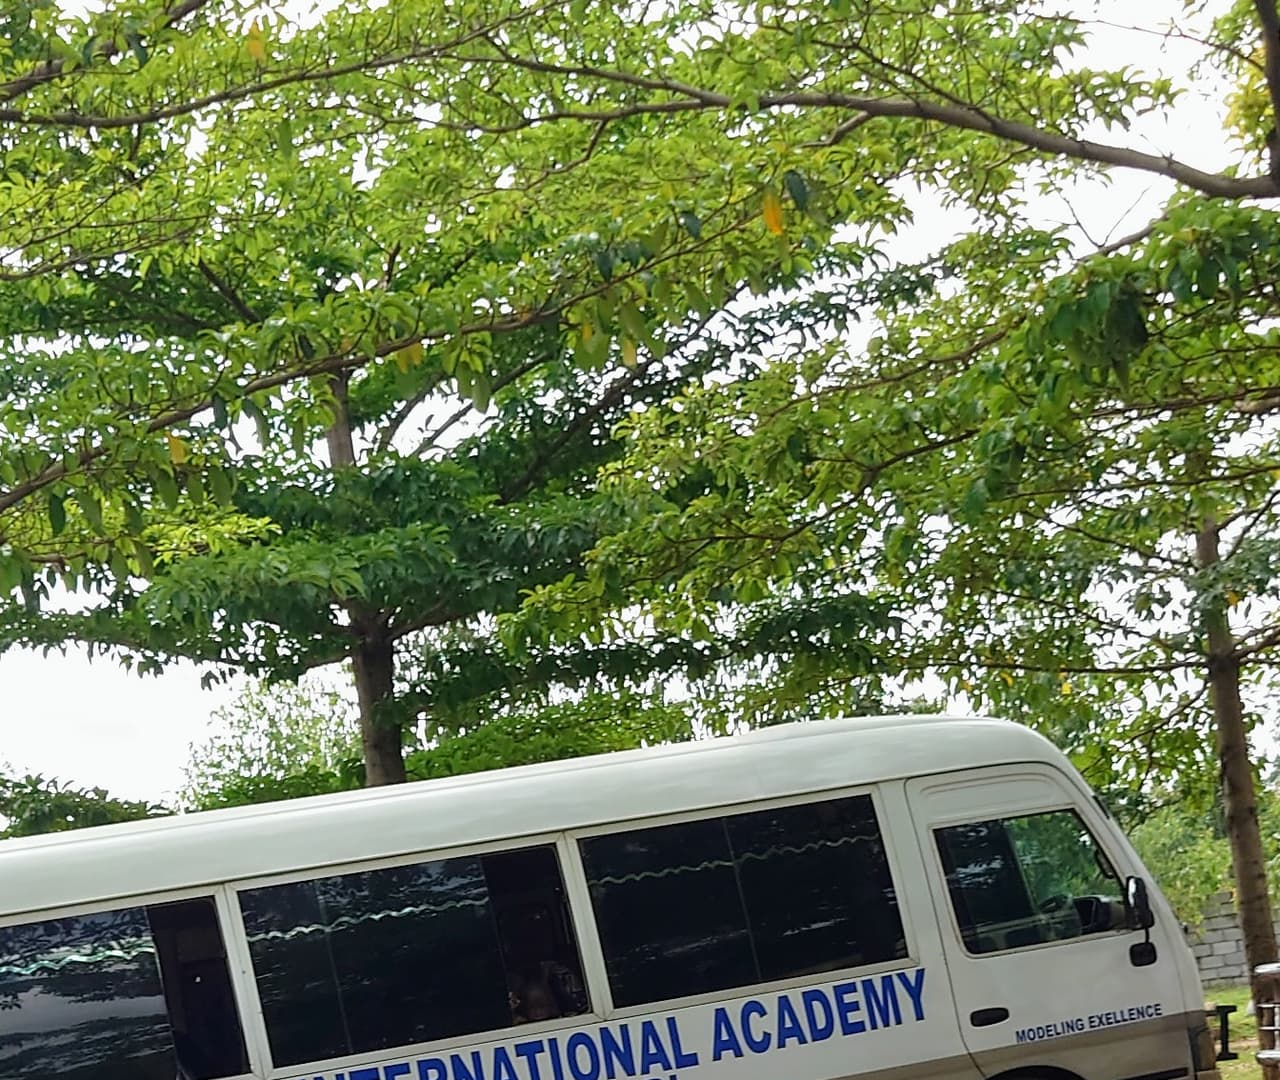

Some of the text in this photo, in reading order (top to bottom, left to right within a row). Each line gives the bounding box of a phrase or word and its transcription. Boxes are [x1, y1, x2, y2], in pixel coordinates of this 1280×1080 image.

[711, 968, 926, 1062] ACADEMY
[1015, 1003, 1163, 1043] MODELING EXELLENCE
